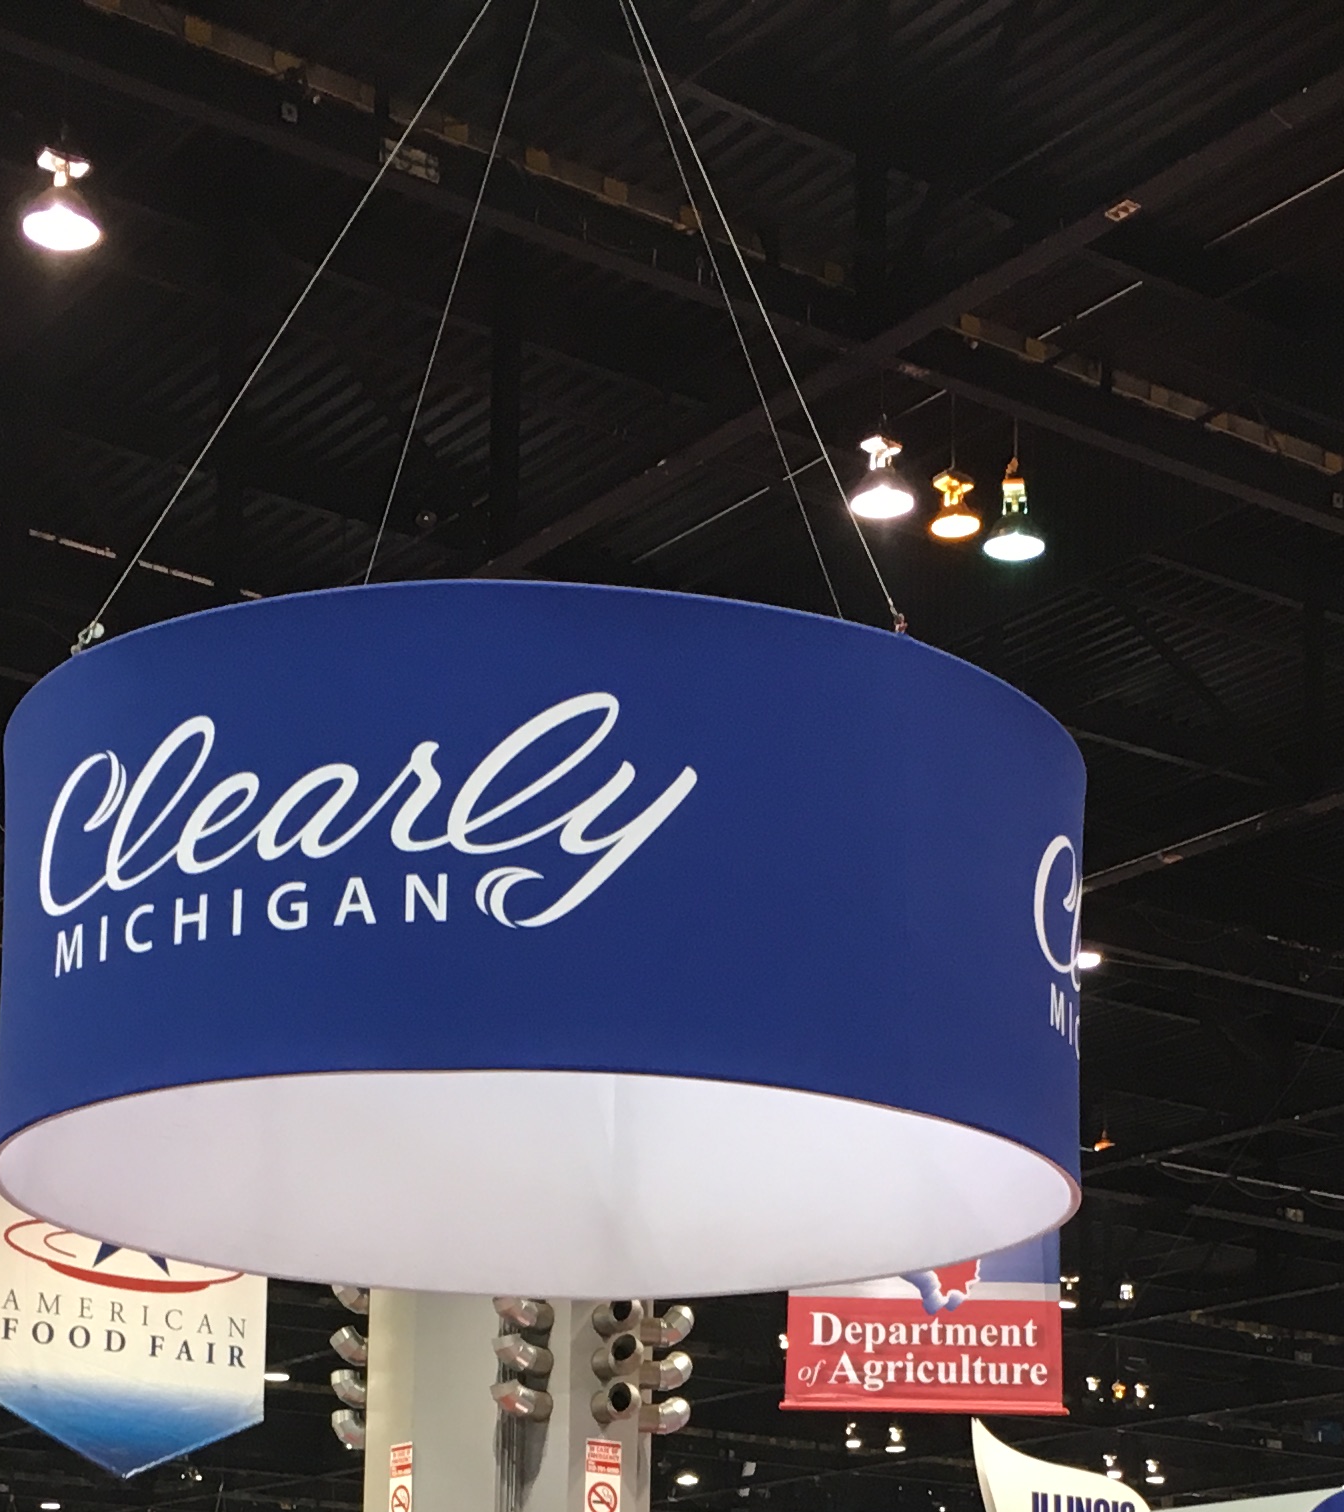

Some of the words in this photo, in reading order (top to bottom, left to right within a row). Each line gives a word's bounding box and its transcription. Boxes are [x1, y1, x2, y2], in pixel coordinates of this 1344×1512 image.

[39, 692, 697, 928] Clearly
[54, 872, 450, 978] MICHIGAN
[2, 1288, 247, 1339] AMERICAN
[809, 1311, 1038, 1354] Department
[2, 1317, 126, 1354] FOOD
[149, 1335, 246, 1369] FAIR
[797, 1359, 827, 1388] of
[829, 1350, 1049, 1392] Agriculture
